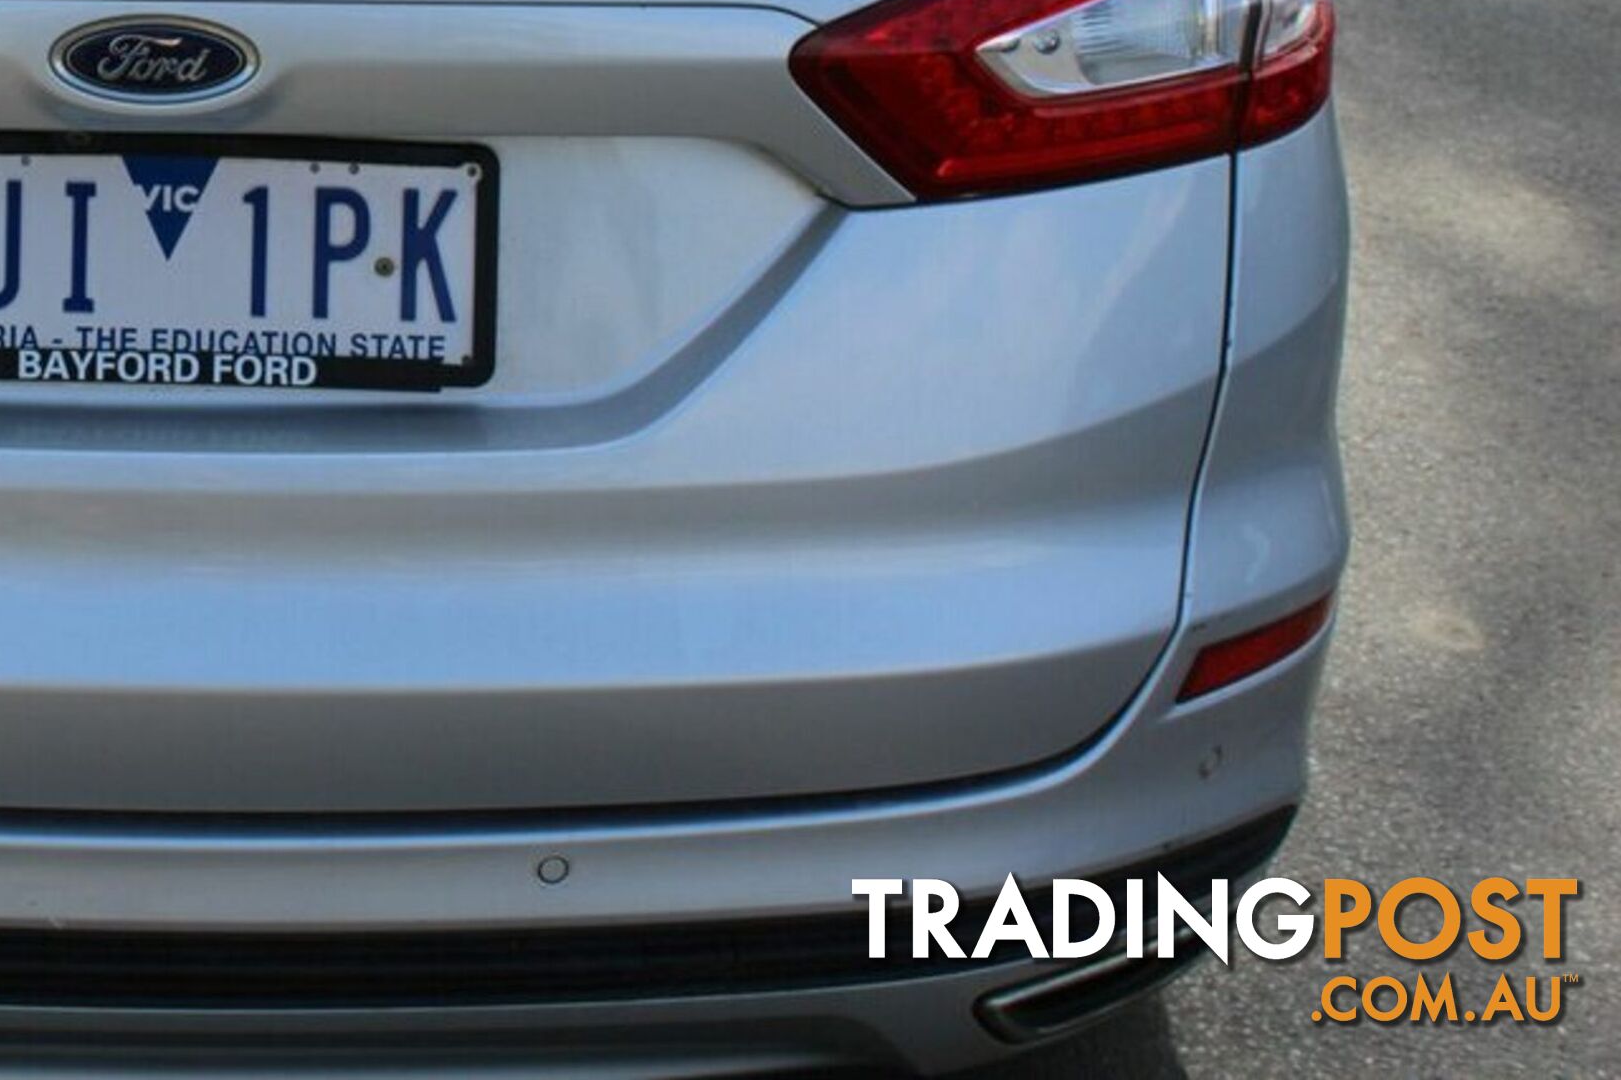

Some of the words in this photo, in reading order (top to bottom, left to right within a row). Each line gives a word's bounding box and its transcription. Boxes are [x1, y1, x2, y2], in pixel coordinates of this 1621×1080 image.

[97, 34, 211, 83] Ford
[134, 184, 200, 213] VIC
[243, 185, 457, 324] 1PK
[77, 326, 139, 351] THE
[151, 329, 336, 357] EDUCATION
[350, 333, 446, 360] STATE
[18, 349, 201, 383] BAYFORD
[212, 353, 318, 386] FORD
